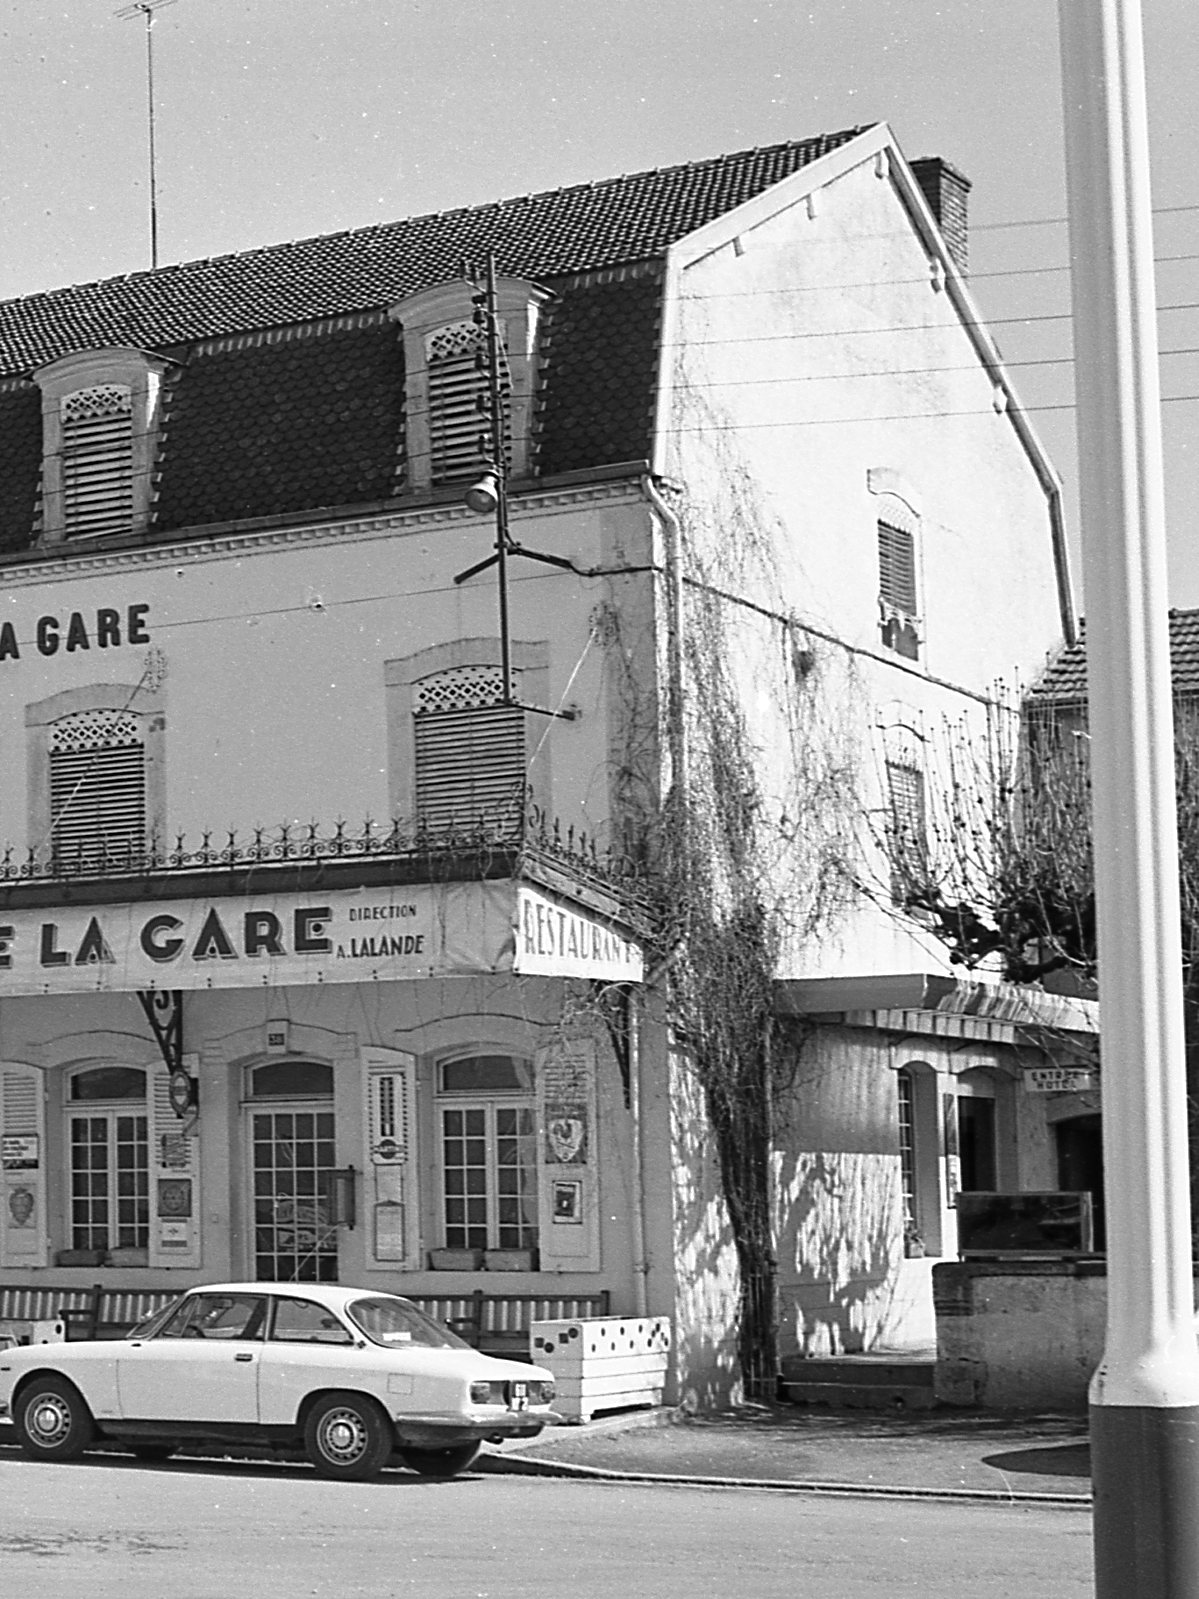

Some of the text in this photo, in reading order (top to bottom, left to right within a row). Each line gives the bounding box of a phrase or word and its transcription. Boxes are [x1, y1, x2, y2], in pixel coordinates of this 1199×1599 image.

[36, 603, 151, 657] GARE
[40, 916, 115, 969] LA
[140, 905, 333, 963] GARE
[348, 904, 417, 921] DIRECTION
[523, 898, 637, 964] RESTAURANT
